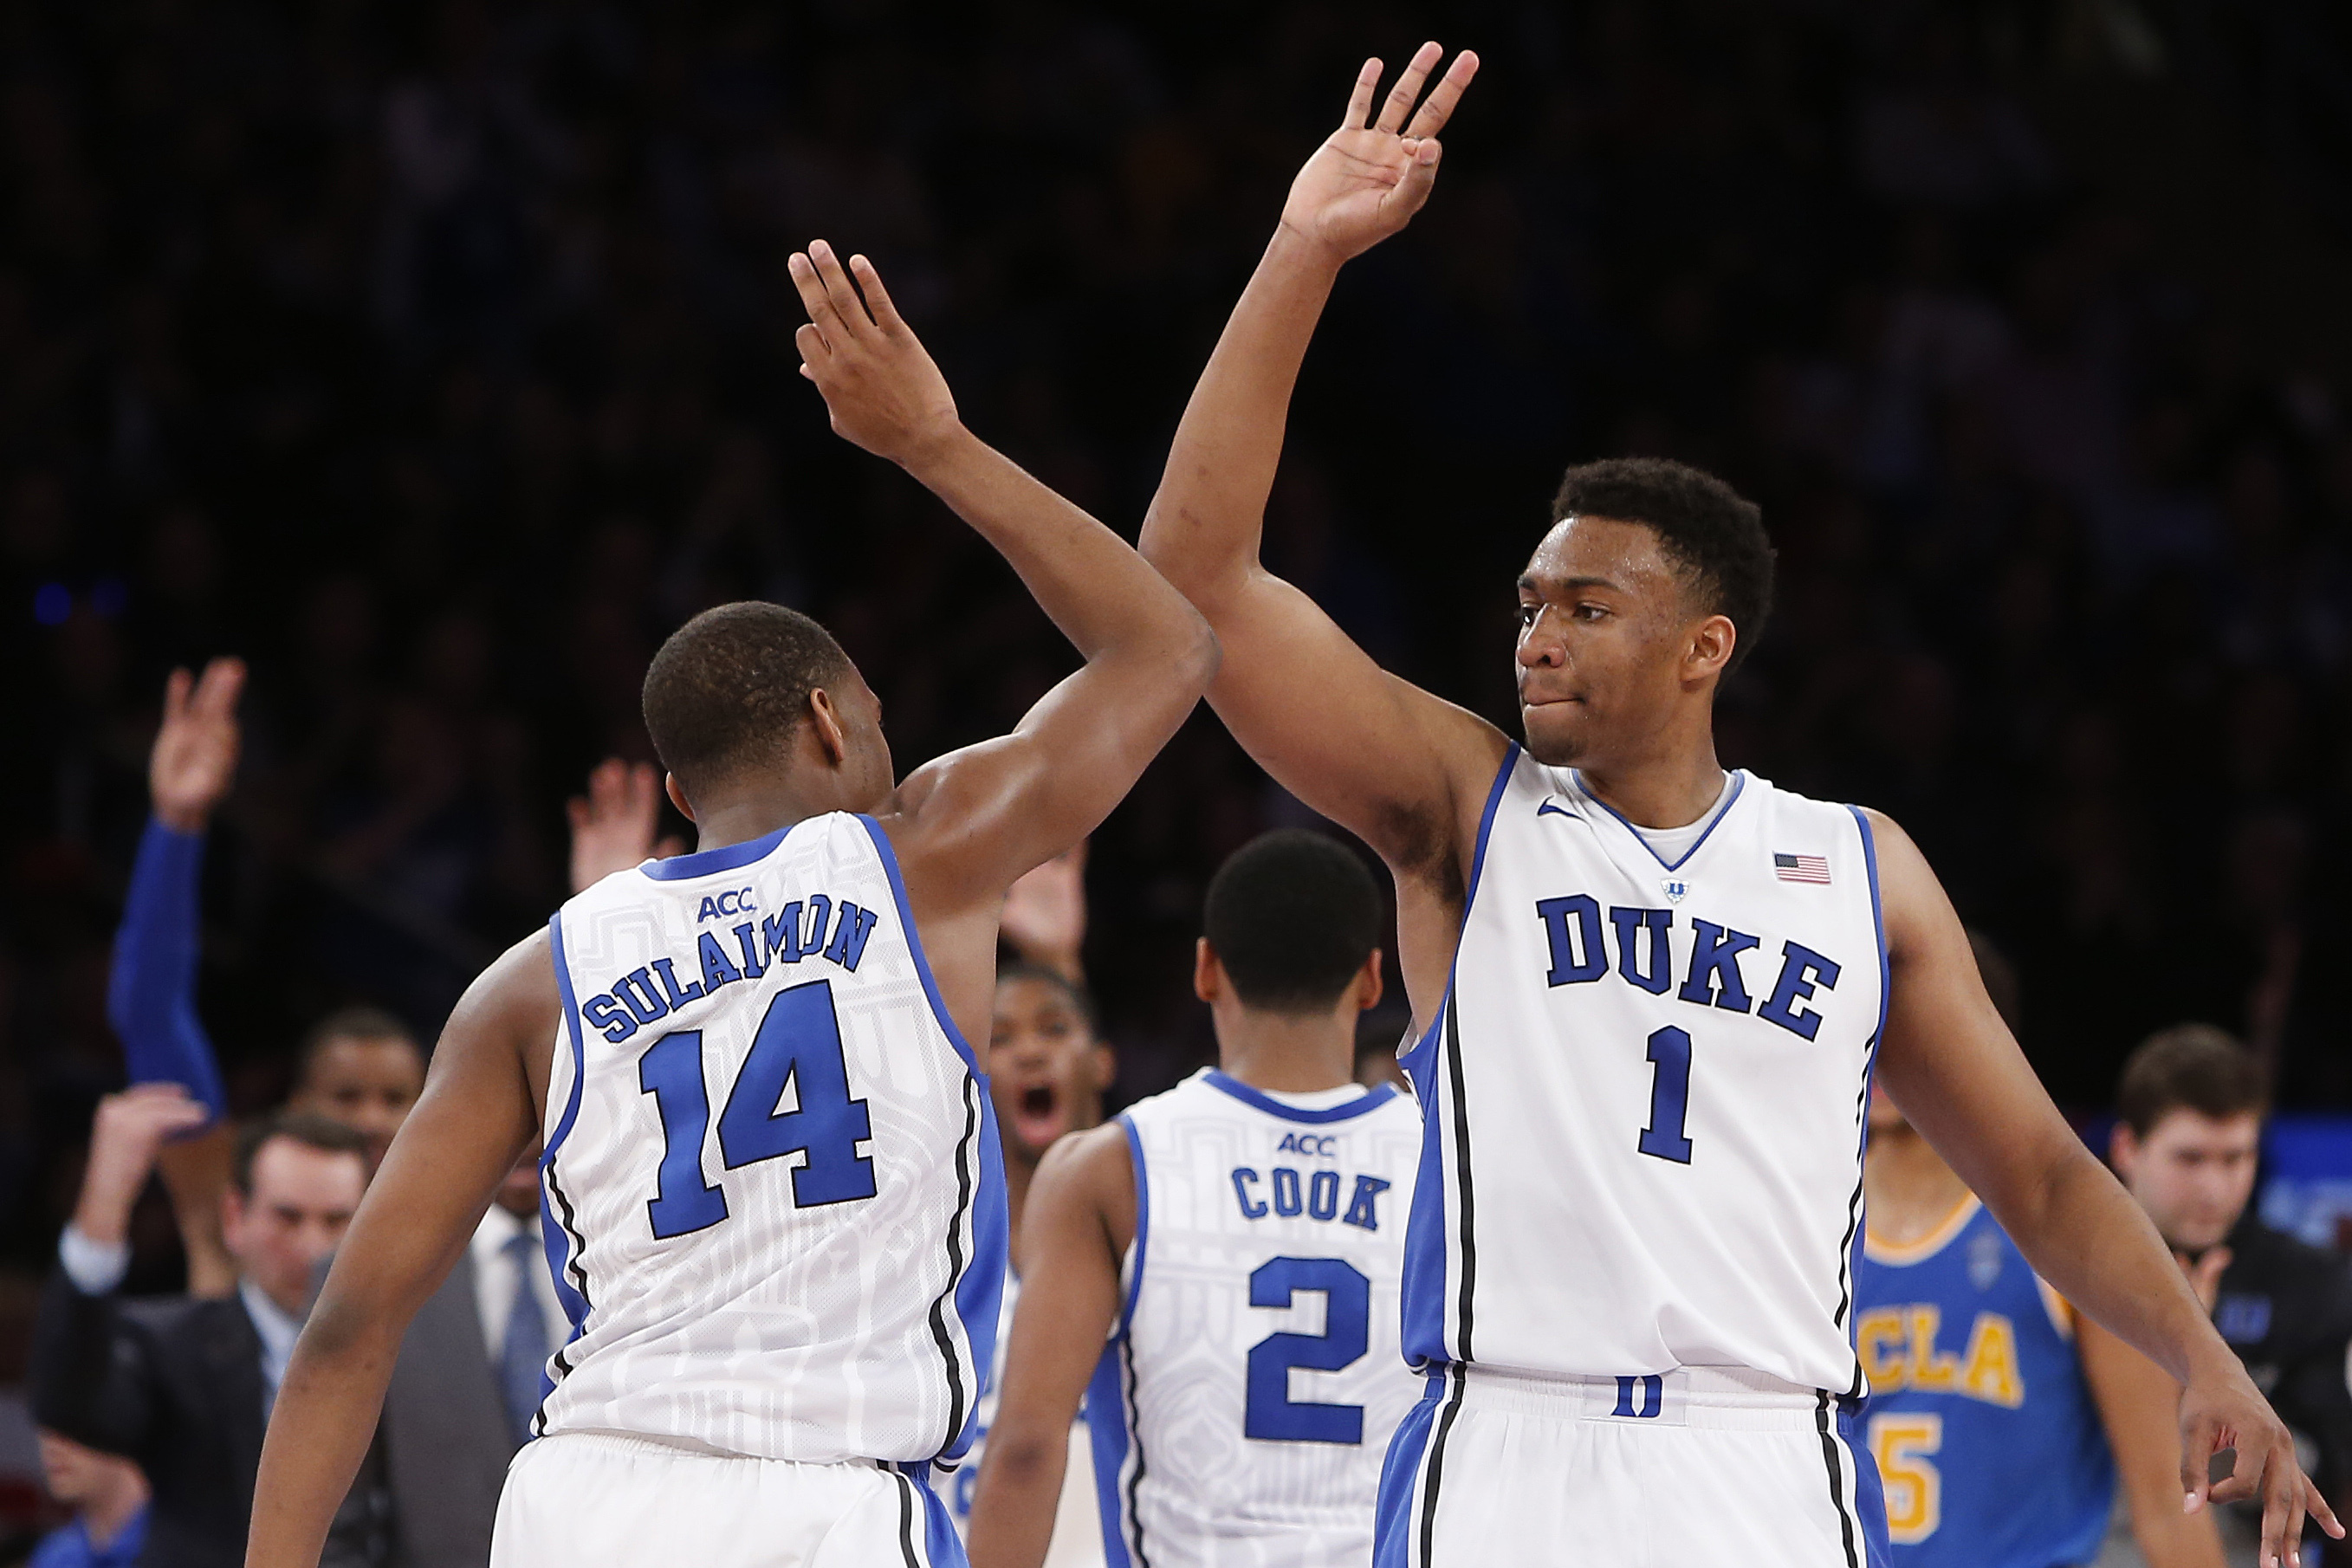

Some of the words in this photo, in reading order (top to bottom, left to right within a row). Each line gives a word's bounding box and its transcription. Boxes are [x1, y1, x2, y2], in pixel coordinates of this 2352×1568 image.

[582, 894, 878, 1044] SULAIMON
[697, 886, 757, 923] ACC
[1536, 893, 1843, 1043] DUKE
[638, 979, 878, 1241] 14
[1277, 1132, 1337, 1157] ACC
[1637, 1025, 1693, 1165] 1
[1231, 1167, 1391, 1232] COOK
[1245, 1256, 1370, 1445] 2
[1856, 1304, 2025, 1410] CLA
[1869, 1413, 1943, 1545] 5
